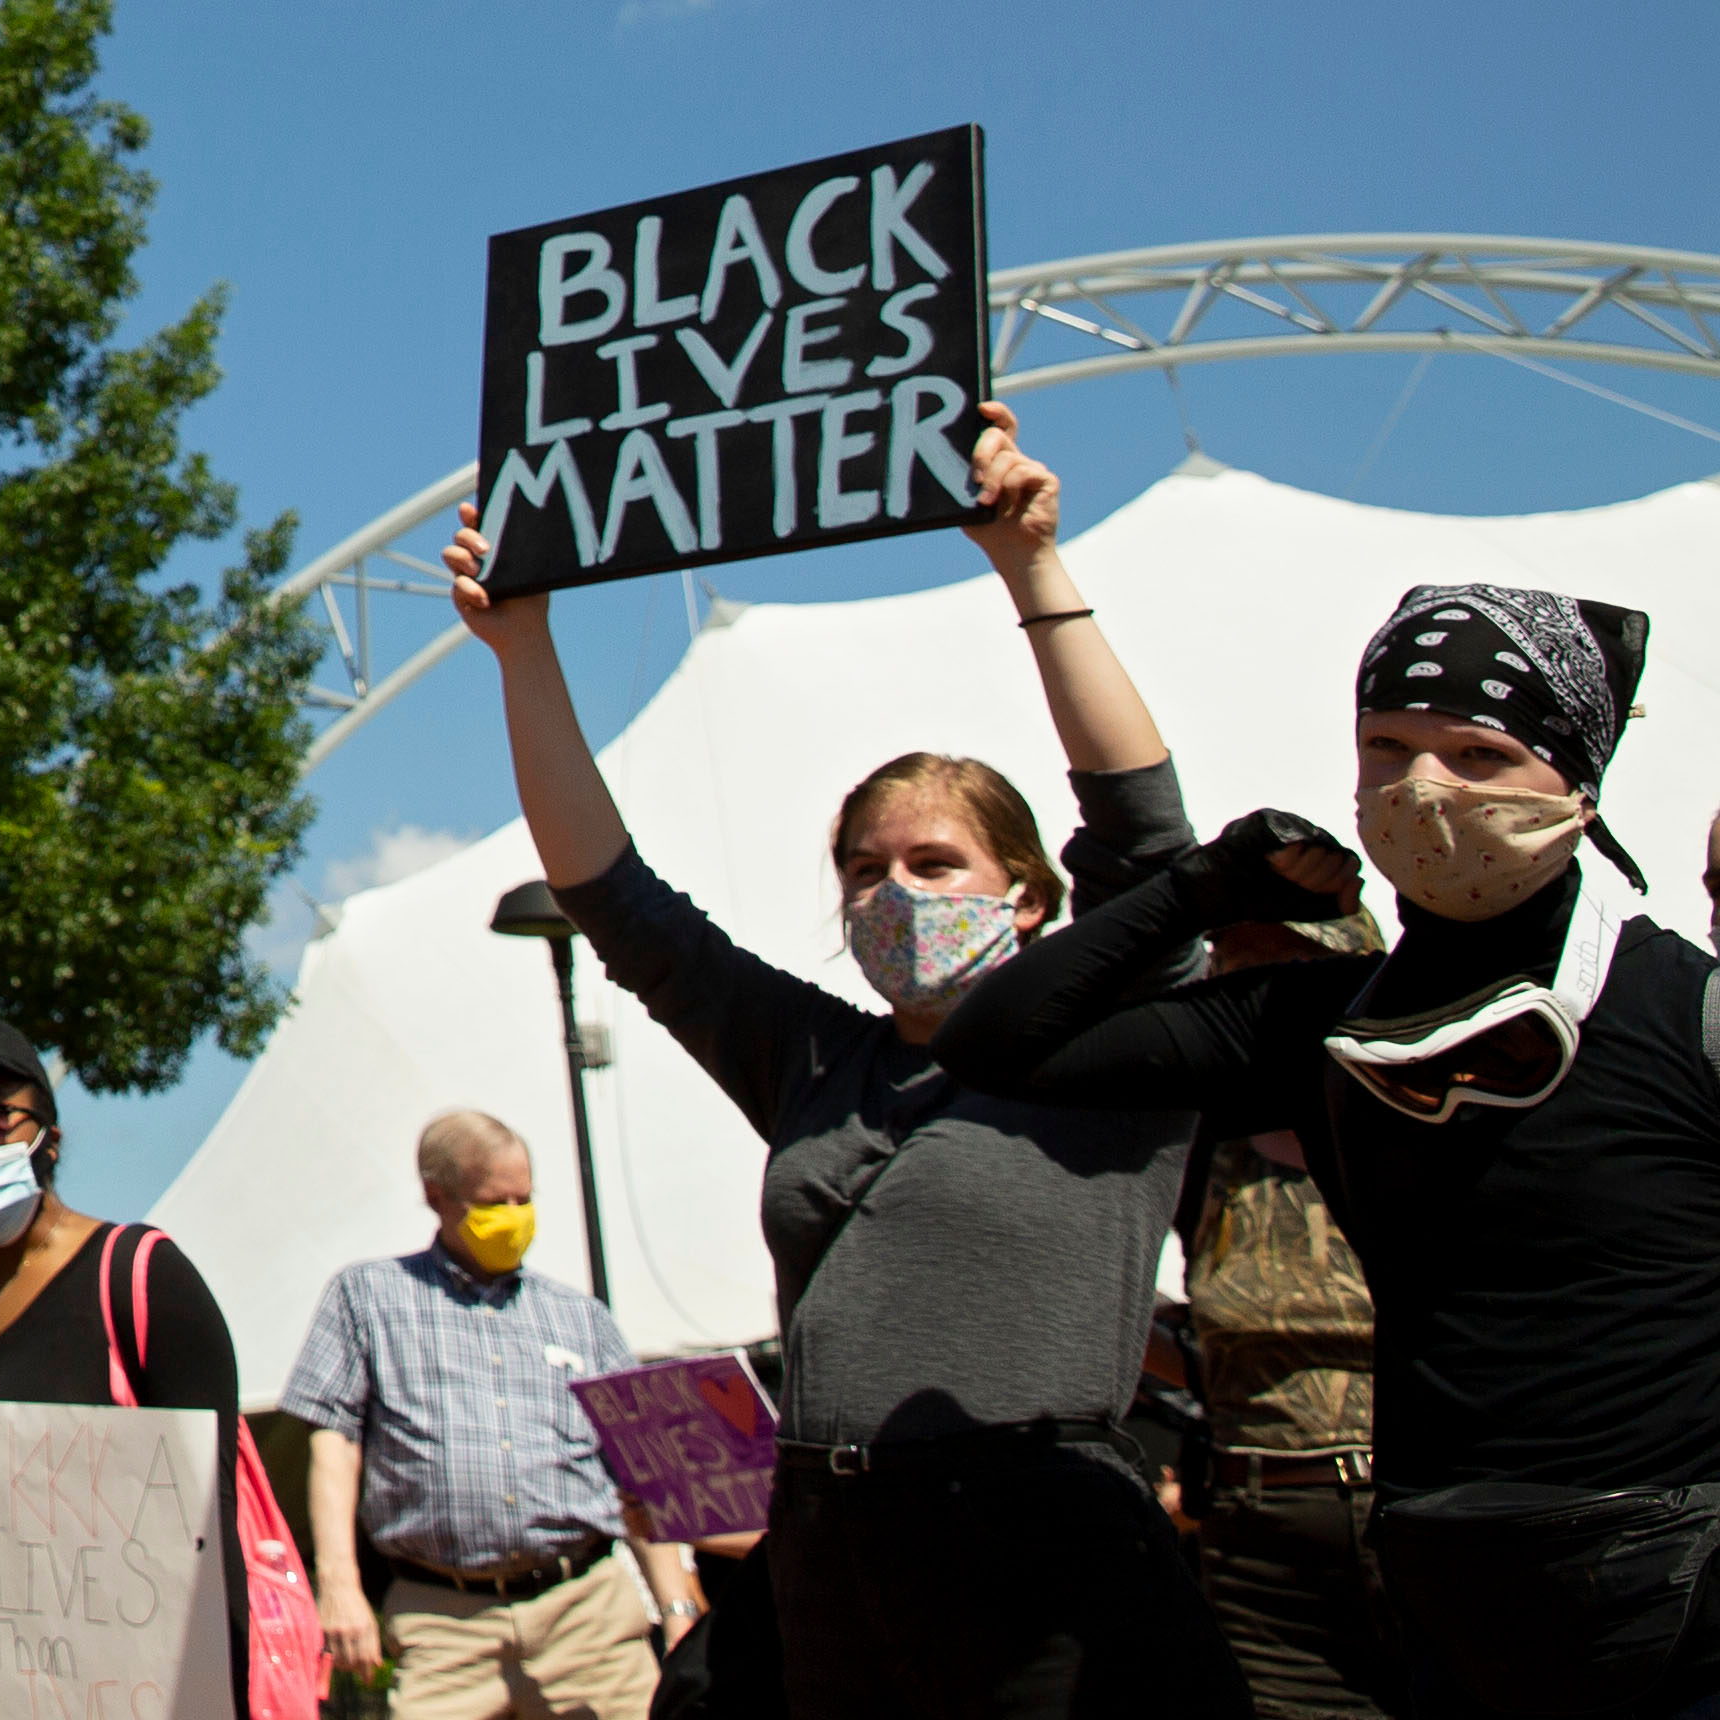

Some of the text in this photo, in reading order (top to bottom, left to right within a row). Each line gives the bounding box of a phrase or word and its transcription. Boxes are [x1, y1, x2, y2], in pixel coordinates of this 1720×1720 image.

[537, 160, 952, 348] BLACK
[525, 282, 939, 446] LIVES
[477, 375, 979, 582] MATTER
[583, 1367, 704, 1427] BLACK
[613, 1421, 729, 1485] LIVES
[644, 1466, 774, 1539] MATT
